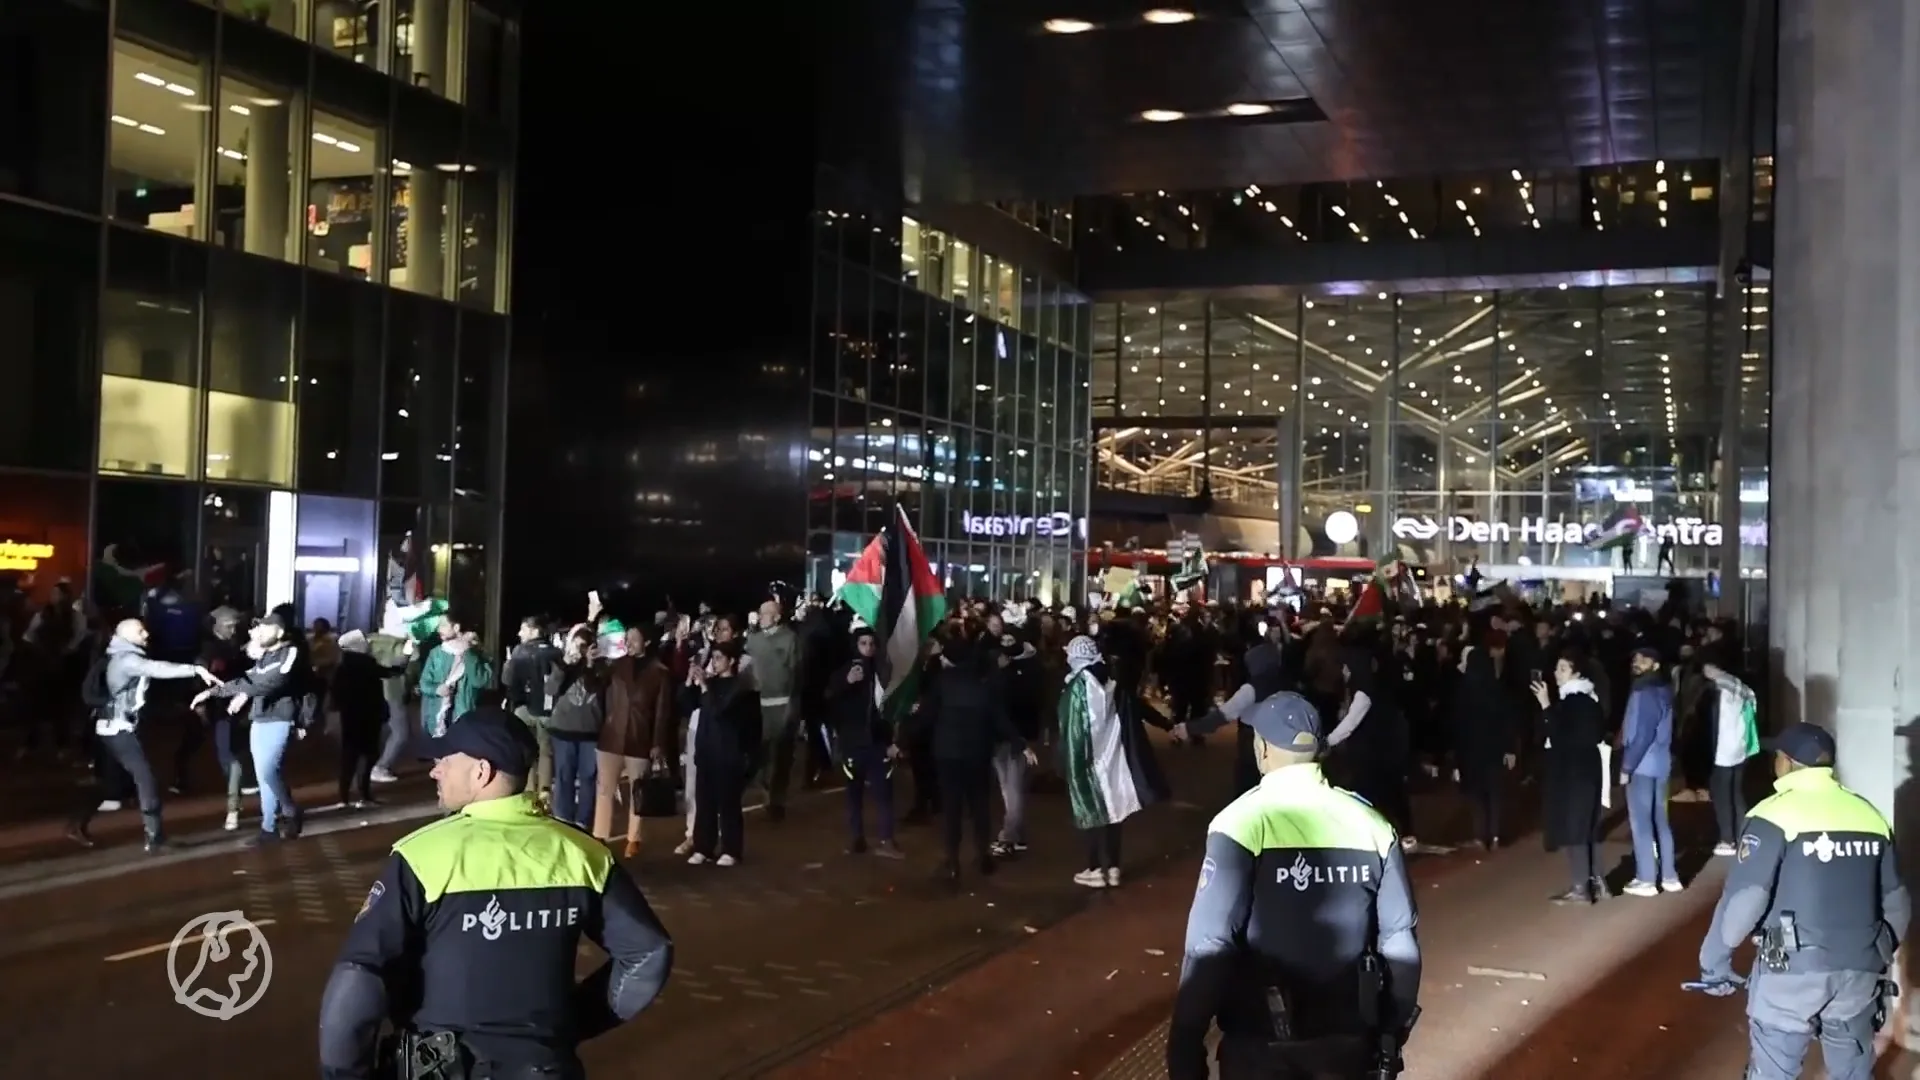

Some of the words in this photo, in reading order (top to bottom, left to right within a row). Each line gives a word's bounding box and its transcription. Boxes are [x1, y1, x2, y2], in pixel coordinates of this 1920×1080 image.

[1448, 516, 1510, 542] Den
[1276, 853, 1370, 891] POLITIE
[462, 895, 578, 940] POLITIE
